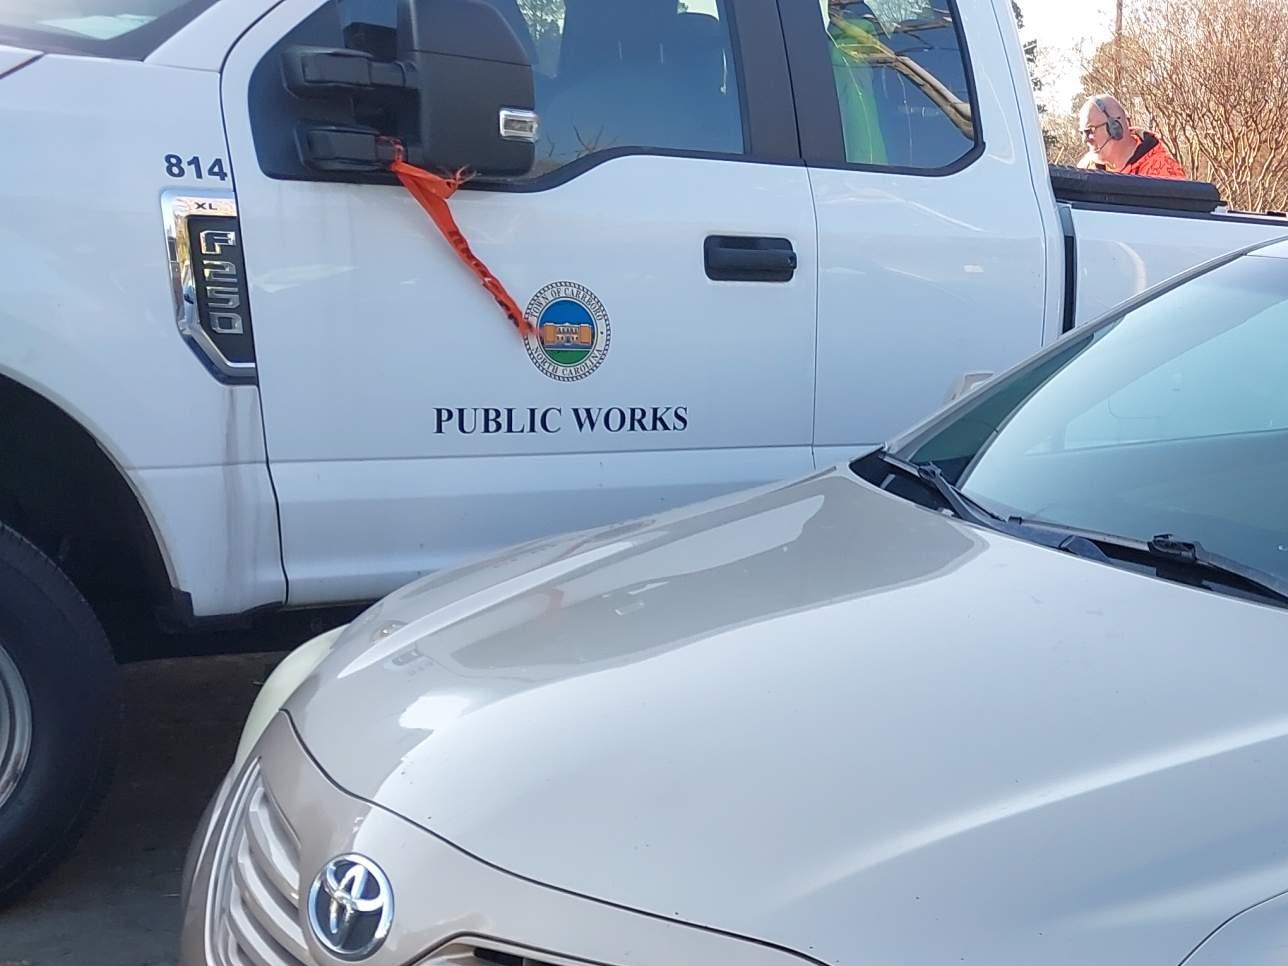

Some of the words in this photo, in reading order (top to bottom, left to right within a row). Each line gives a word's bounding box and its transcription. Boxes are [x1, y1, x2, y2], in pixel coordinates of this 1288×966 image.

[164, 154, 228, 181] 814
[194, 202, 218, 210] XL
[200, 230, 244, 335] F250
[529, 294, 549, 318] TOWN
[550, 287, 562, 298] OF
[563, 287, 604, 321] CARRBORO
[532, 346, 559, 374] NORTH
[561, 348, 603, 377] CAROLINA
[433, 407, 562, 434] PUBLIC
[571, 406, 688, 432] WORKS
